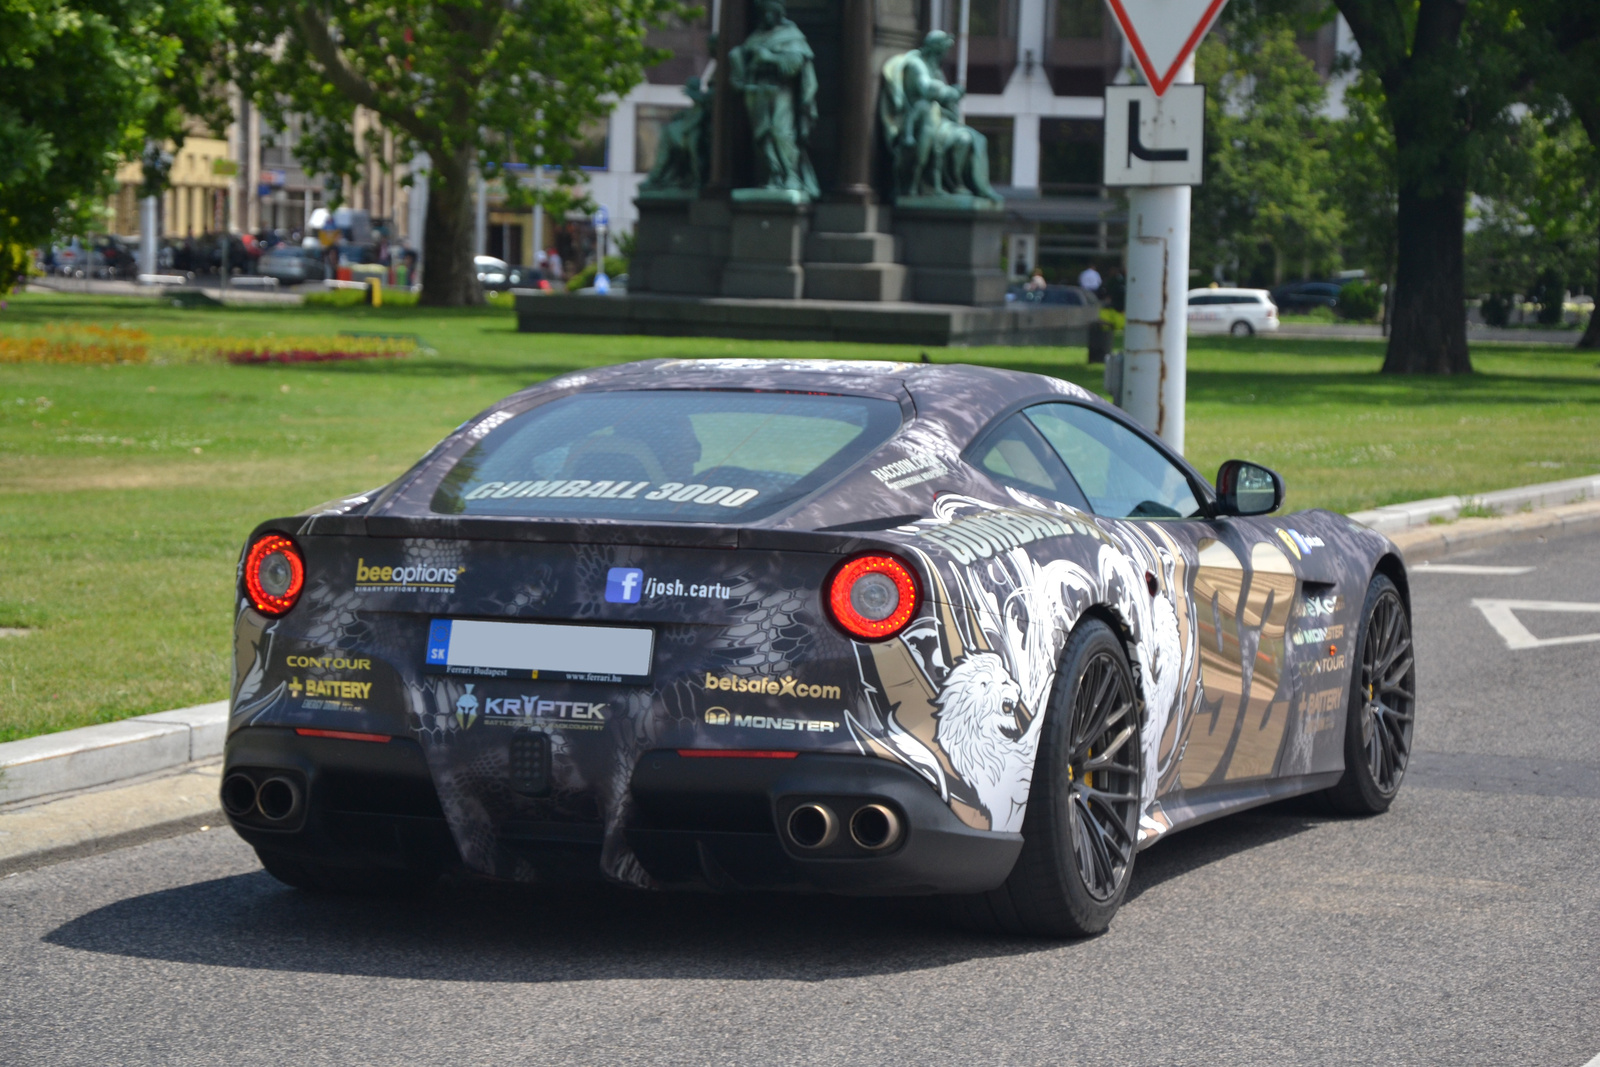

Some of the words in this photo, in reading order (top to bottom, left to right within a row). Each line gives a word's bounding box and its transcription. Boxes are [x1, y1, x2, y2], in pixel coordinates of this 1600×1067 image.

[464, 480, 650, 500] GUMBALL
[645, 482, 759, 508] 3000
[356, 558, 457, 586] beeoptions
[384, 586, 417, 594] OPTIONS
[645, 577, 731, 599] /josh.cartu
[286, 655, 371, 670] CONTOUR
[431, 648, 445, 660] SK
[446, 665, 472, 675] Ferrari
[474, 667, 508, 677] Budapest
[566, 672, 622, 683] www.ferrari.hu
[305, 679, 372, 699] BATTERY
[484, 694, 606, 719] KRYPTEK
[735, 714, 834, 733] MONSTER
